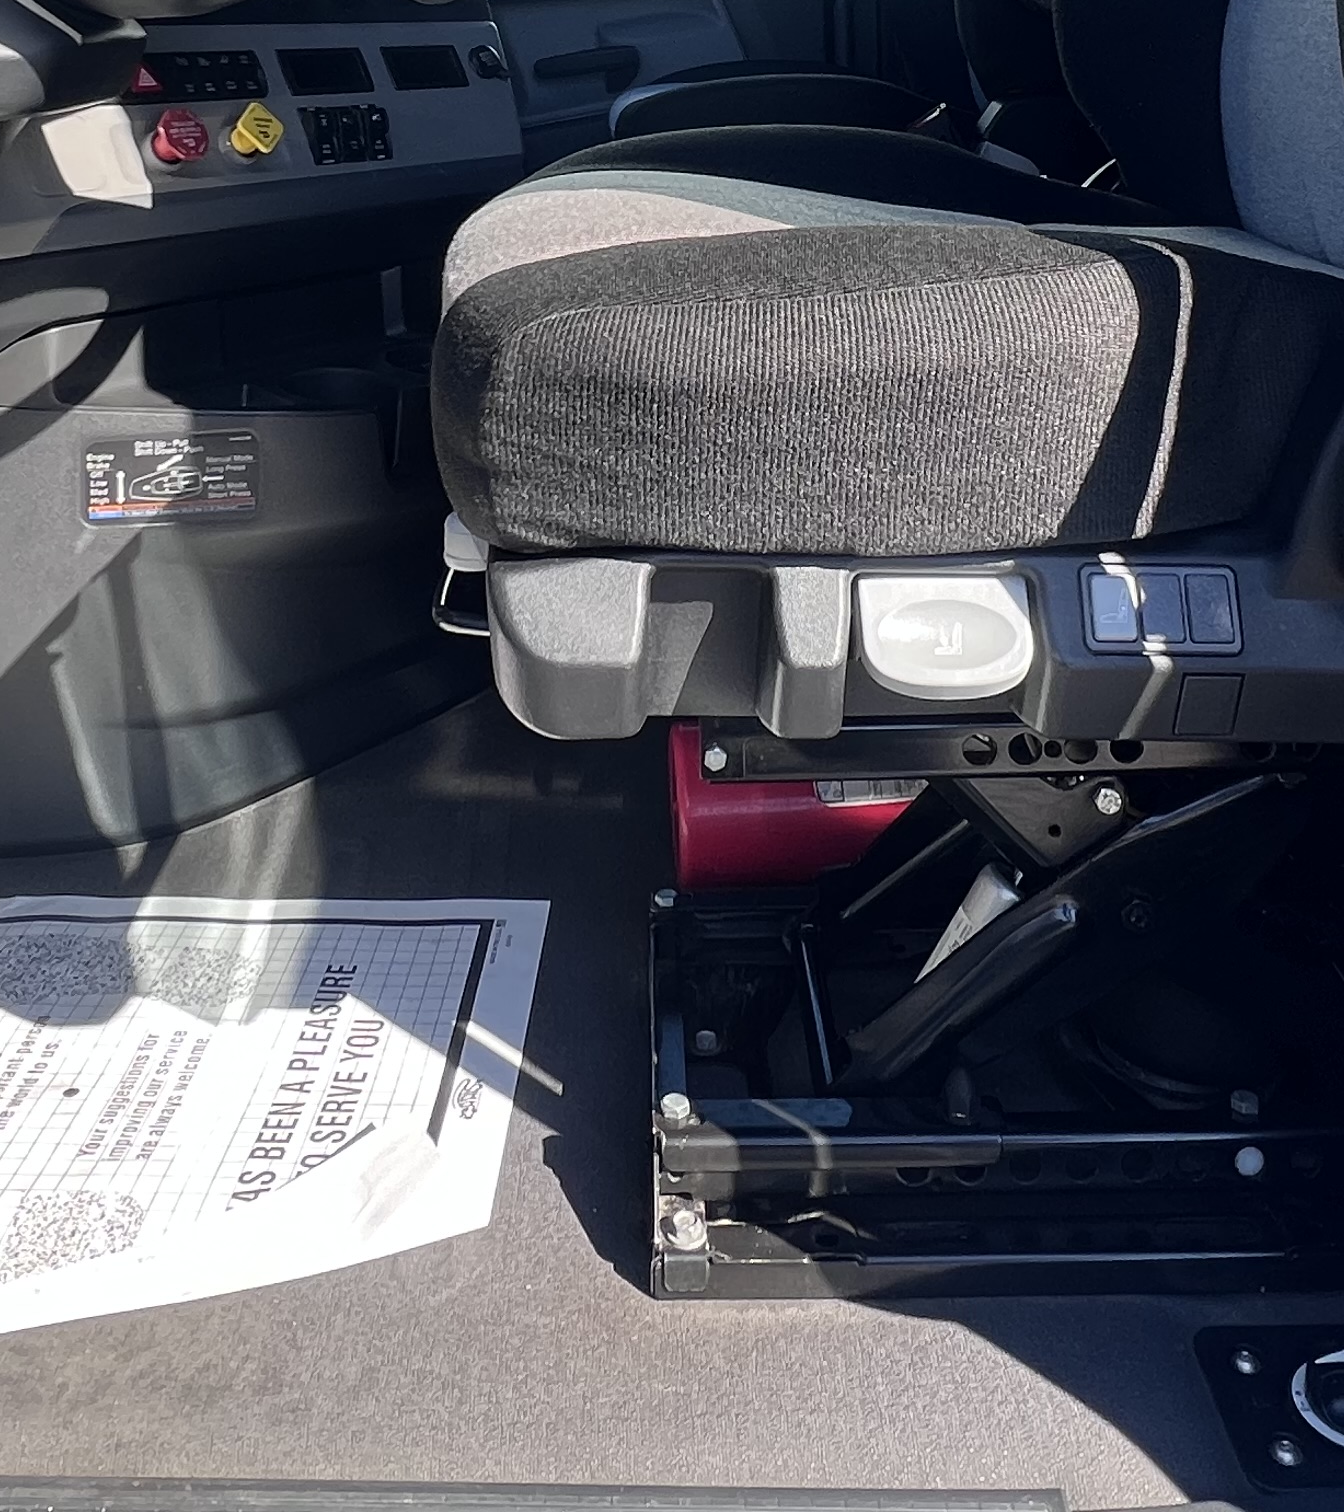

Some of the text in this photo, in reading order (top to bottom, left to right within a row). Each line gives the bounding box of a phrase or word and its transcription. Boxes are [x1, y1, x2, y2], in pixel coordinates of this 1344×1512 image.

[6, 1077, 39, 1108] world
[27, 1062, 49, 1074] to
[76, 1033, 160, 1158] Your suggestions for
[101, 1030, 188, 1162] improving our service
[135, 1140, 159, 1161] are
[148, 1095, 183, 1137] always
[225, 964, 358, 1212] AS BEEN A PLEASURE
[295, 1019, 385, 1179] O SERVE YOU
